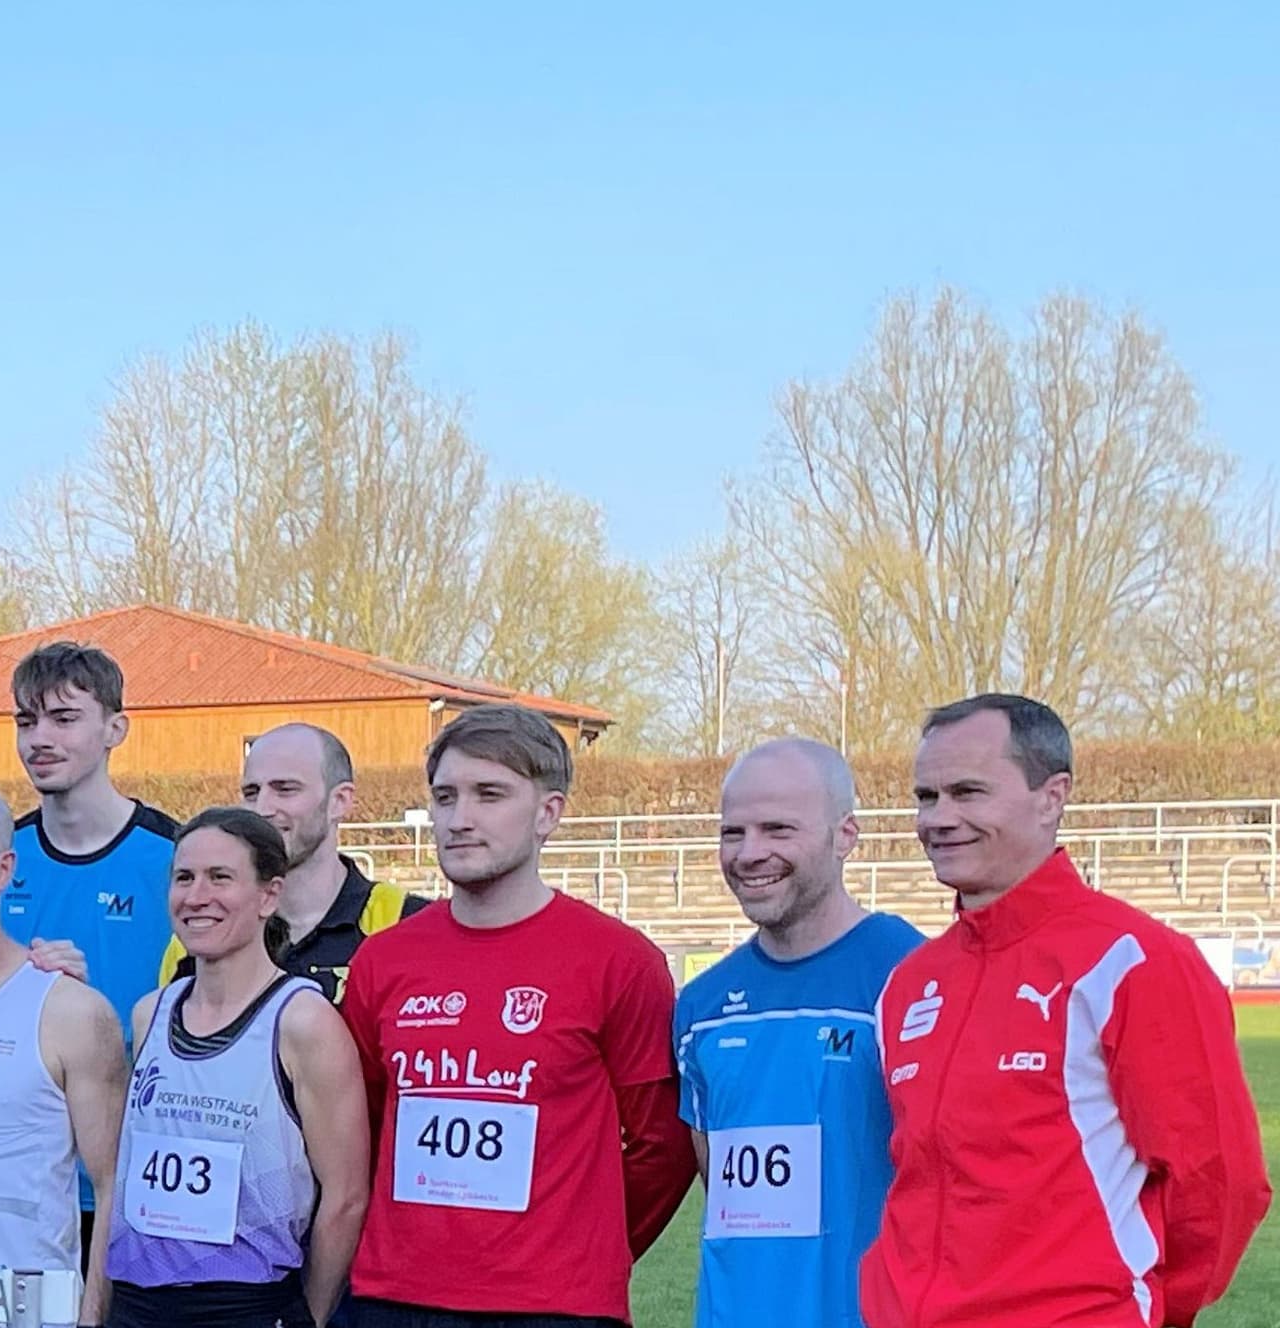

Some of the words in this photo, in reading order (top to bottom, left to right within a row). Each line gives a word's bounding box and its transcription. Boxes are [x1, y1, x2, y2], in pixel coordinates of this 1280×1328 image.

[398, 996, 444, 1016] AOK
[204, 1113, 229, 1127] 1973
[416, 1114, 504, 1161] 408
[142, 1149, 212, 1195] 403
[722, 1144, 791, 1189] 406
